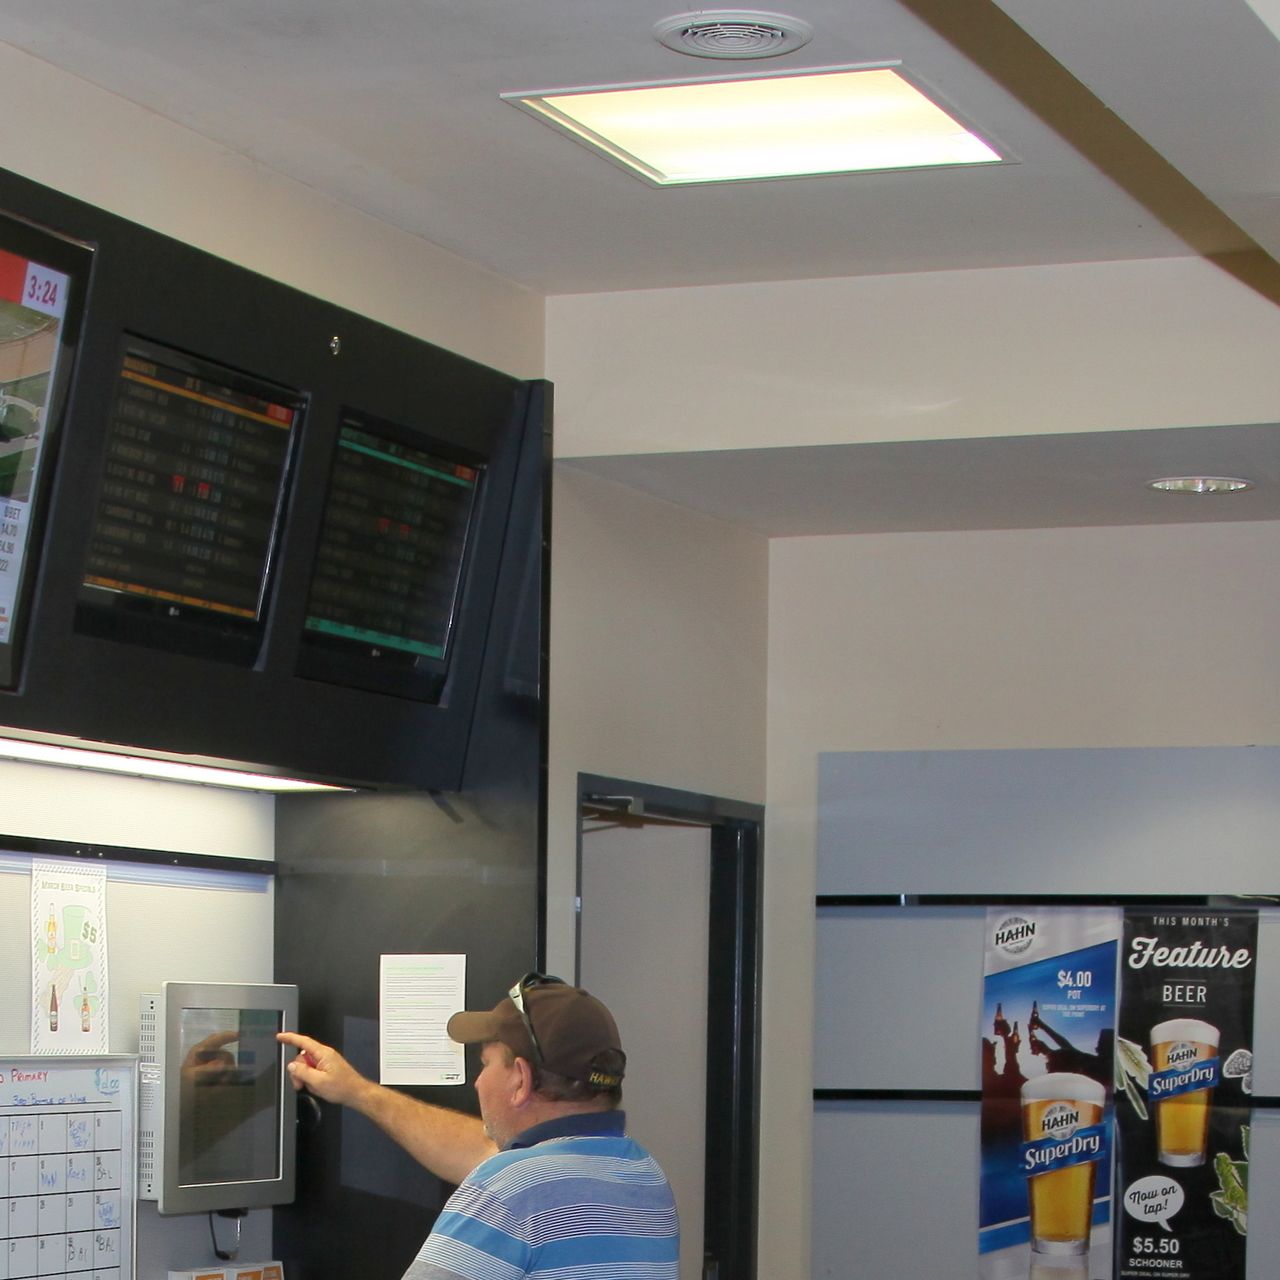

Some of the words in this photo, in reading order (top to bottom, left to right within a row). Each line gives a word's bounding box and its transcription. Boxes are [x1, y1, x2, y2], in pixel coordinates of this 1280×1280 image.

[26, 276, 59, 306] 3:24
[1153, 917, 1176, 926] THIS
[1182, 917, 1229, 927] MONTH'S
[82, 920, 97, 944] $5
[995, 922, 1036, 945] HAHN
[1129, 936, 1252, 969] Feature
[1057, 970, 1092, 988] $4.00
[1067, 990, 1081, 999] POT
[1163, 985, 1207, 1003] BEER
[1167, 1048, 1198, 1065] HAHN
[1153, 1066, 1214, 1095] SuperDry
[1042, 1111, 1079, 1131] HAHN
[1025, 1135, 1100, 1170] SuperDry
[1129, 1190, 1159, 1205] Now
[1161, 1186, 1177, 1196] on
[1144, 1199, 1169, 1216] tap!
[1133, 1237, 1180, 1254] $5.50
[1129, 1259, 1183, 1269] SCHOONER
